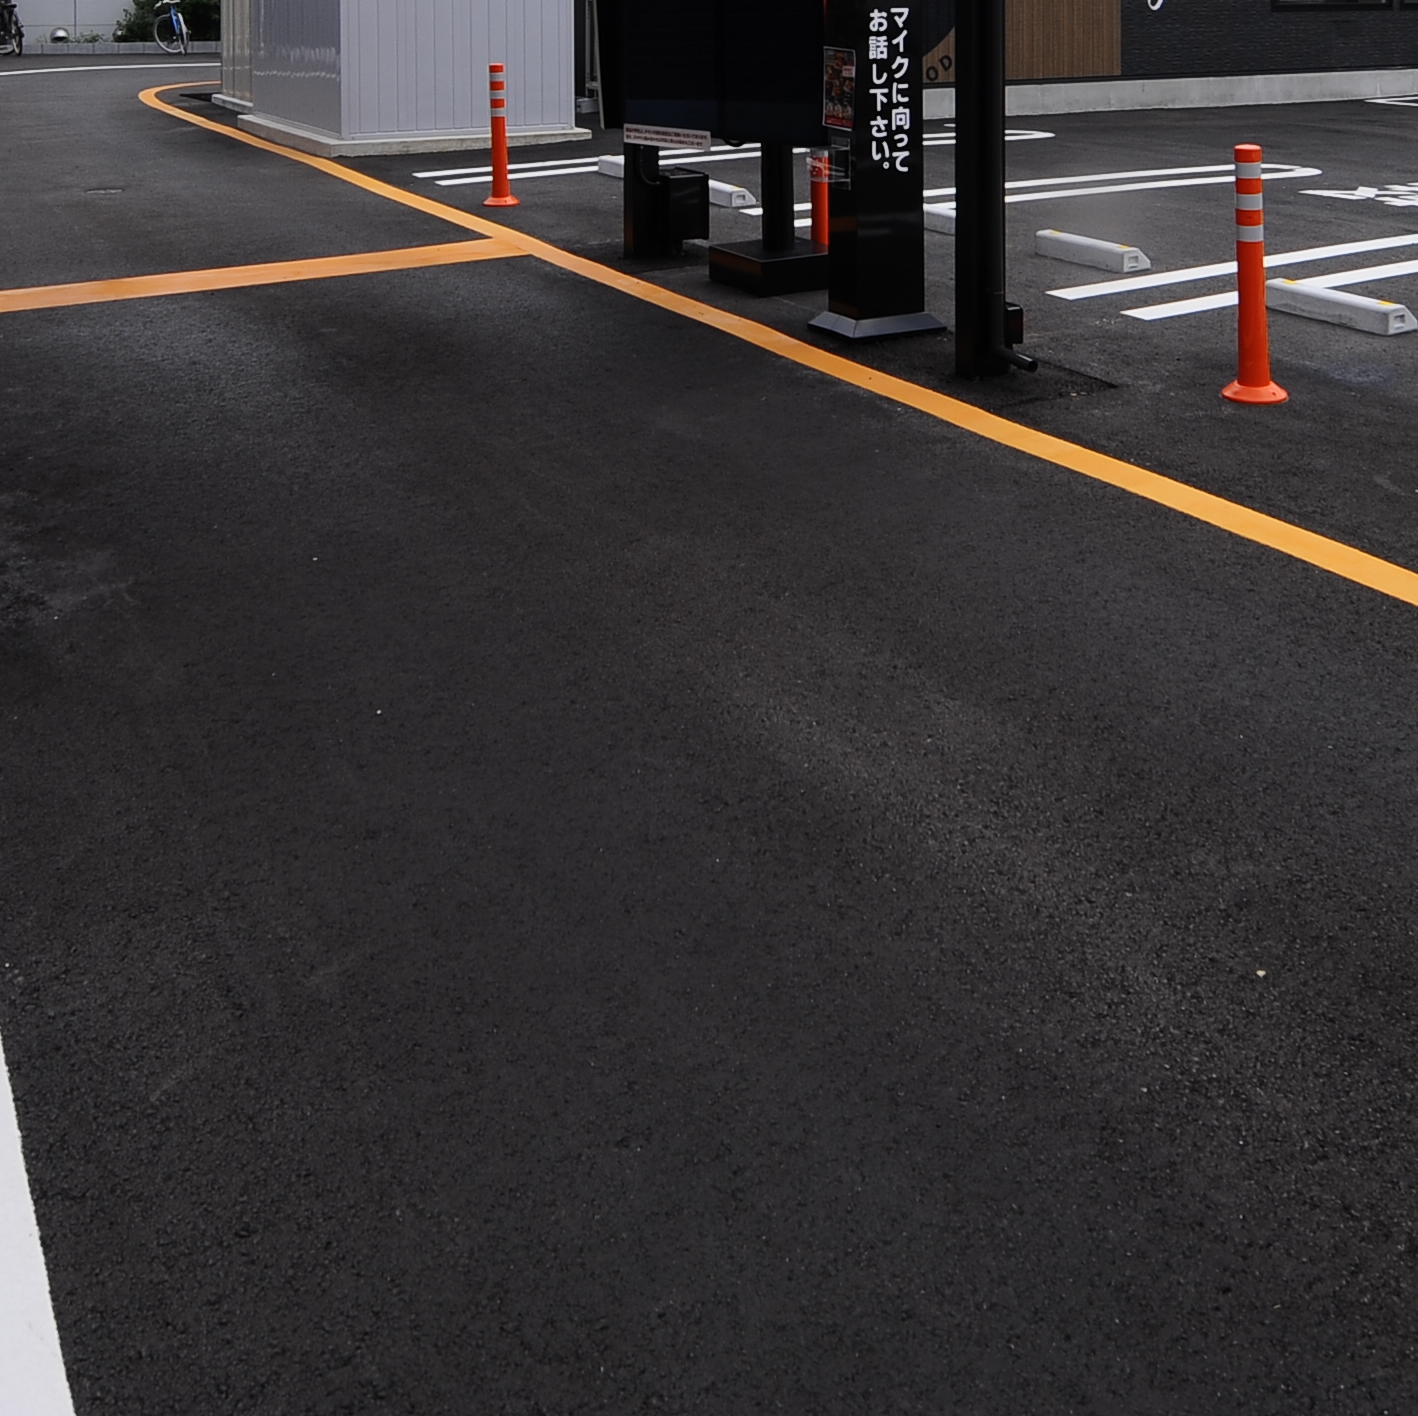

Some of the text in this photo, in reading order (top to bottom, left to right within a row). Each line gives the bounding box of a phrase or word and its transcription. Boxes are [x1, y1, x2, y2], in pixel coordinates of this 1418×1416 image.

[868, 8, 890, 170] お話し下さい。
[890, 7, 910, 172] マイクに向って
